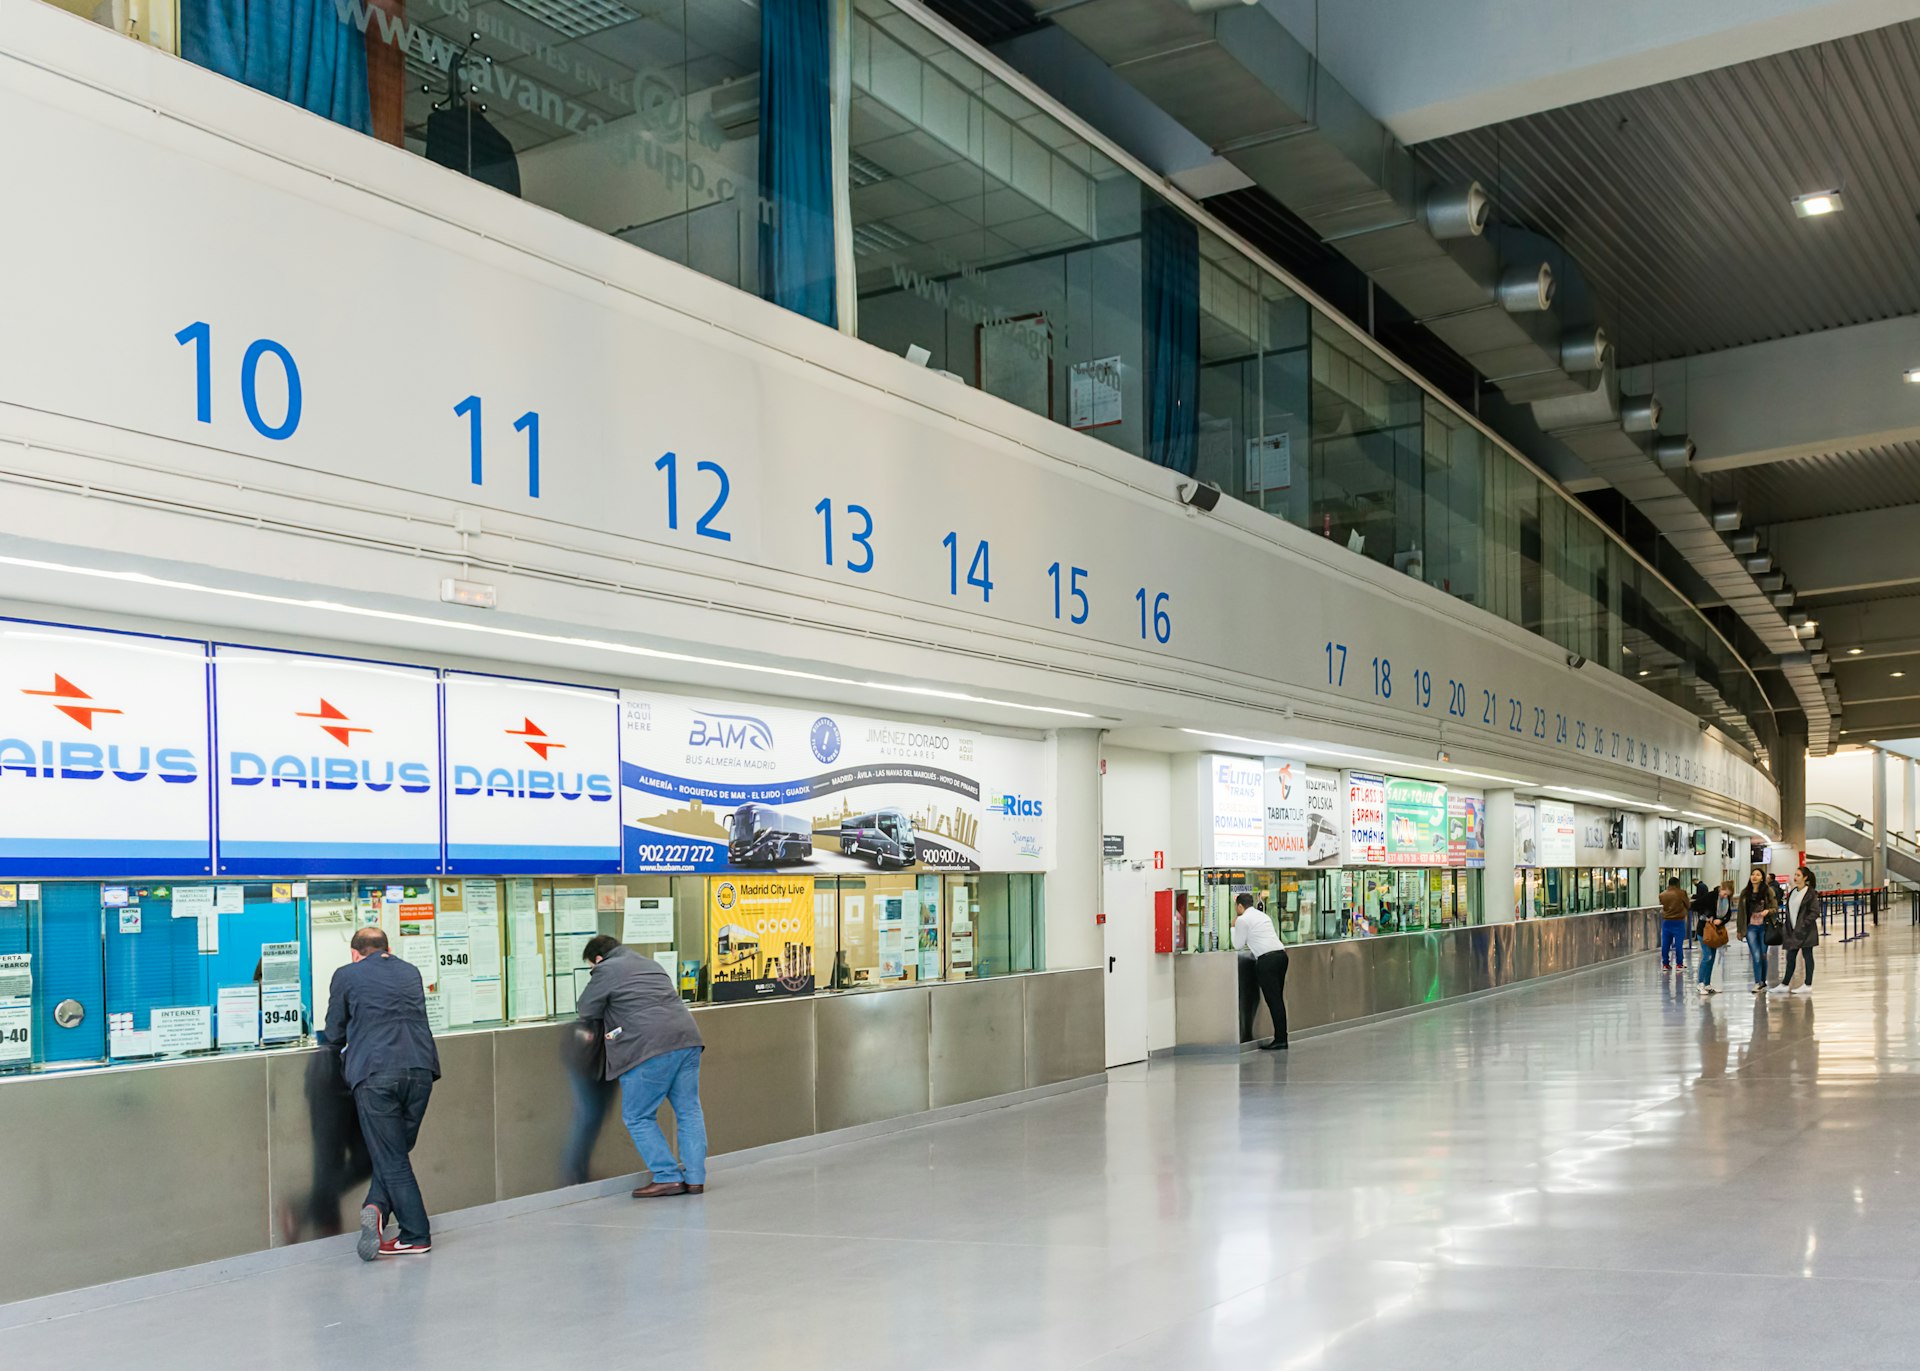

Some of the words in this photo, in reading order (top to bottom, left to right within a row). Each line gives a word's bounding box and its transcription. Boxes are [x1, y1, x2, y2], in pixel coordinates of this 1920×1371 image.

[176, 321, 302, 441] 10
[454, 396, 539, 499] 11
[656, 451, 732, 542] 12
[816, 498, 875, 574] 13
[943, 532, 994, 604] 14
[1047, 562, 1089, 625] 15
[1135, 587, 1171, 644] 16
[1325, 641, 1348, 686] 17
[1372, 657, 1392, 699] 18
[1413, 669, 1431, 709] 19
[1449, 679, 1466, 718] 20
[1483, 689, 1497, 726] 21
[1509, 698, 1522, 733] 22
[627, 722, 653, 733] HERE
[689, 720, 748, 750] BAM
[1534, 707, 1546, 739] 23
[1556, 713, 1568, 744] 24
[1576, 720, 1586, 750] 25
[866, 727, 906, 747] JIMÉNEZ
[907, 732, 950, 751] DORADO
[1594, 727, 1604, 754] 26
[1612, 732, 1620, 758] 27
[0, 738, 198, 783] AIBUS
[686, 755, 704, 766] BUS
[705, 757, 742, 770] ALMERÍA
[744, 760, 777, 772] MADRID
[879, 747, 937, 761] AUTOCARES
[230, 752, 431, 794] DAIBUS
[454, 766, 613, 803] DAIBUS
[638, 774, 674, 792] ALMERÍA
[679, 785, 719, 800] ROQUETAS
[719, 790, 730, 800] DE
[730, 791, 747, 801] MAR
[751, 790, 760, 800] EL
[760, 788, 781, 800] EJIDO
[786, 784, 811, 798] GUADIX
[831, 775, 854, 786] MADRID
[875, 768, 886, 778] LAS
[886, 769, 904, 778] NAVAS
[904, 769, 914, 778] DEL
[939, 774, 954, 785] HOYO
[954, 778, 961, 788] DE
[960, 780, 979, 796] PINARES
[1219, 765, 1262, 787] ELITUR
[1003, 794, 1043, 817] Rias
[1229, 786, 1255, 798] TRANS
[1308, 796, 1333, 811] POLSKA
[1214, 816, 1253, 830] ROMANIA
[638, 844, 665, 863] 902
[664, 845, 690, 863] 227
[690, 845, 715, 864] 272
[639, 862, 696, 873] www.busbam.com
[922, 849, 940, 864] 900
[939, 849, 957, 864] 900
[740, 884, 768, 897] Madrid
[770, 883, 789, 900] City
[792, 884, 806, 896] Live
[439, 952, 469, 967] 39-40
[161, 1009, 201, 1017] INTERNET
[264, 1009, 299, 1025] 39-40
